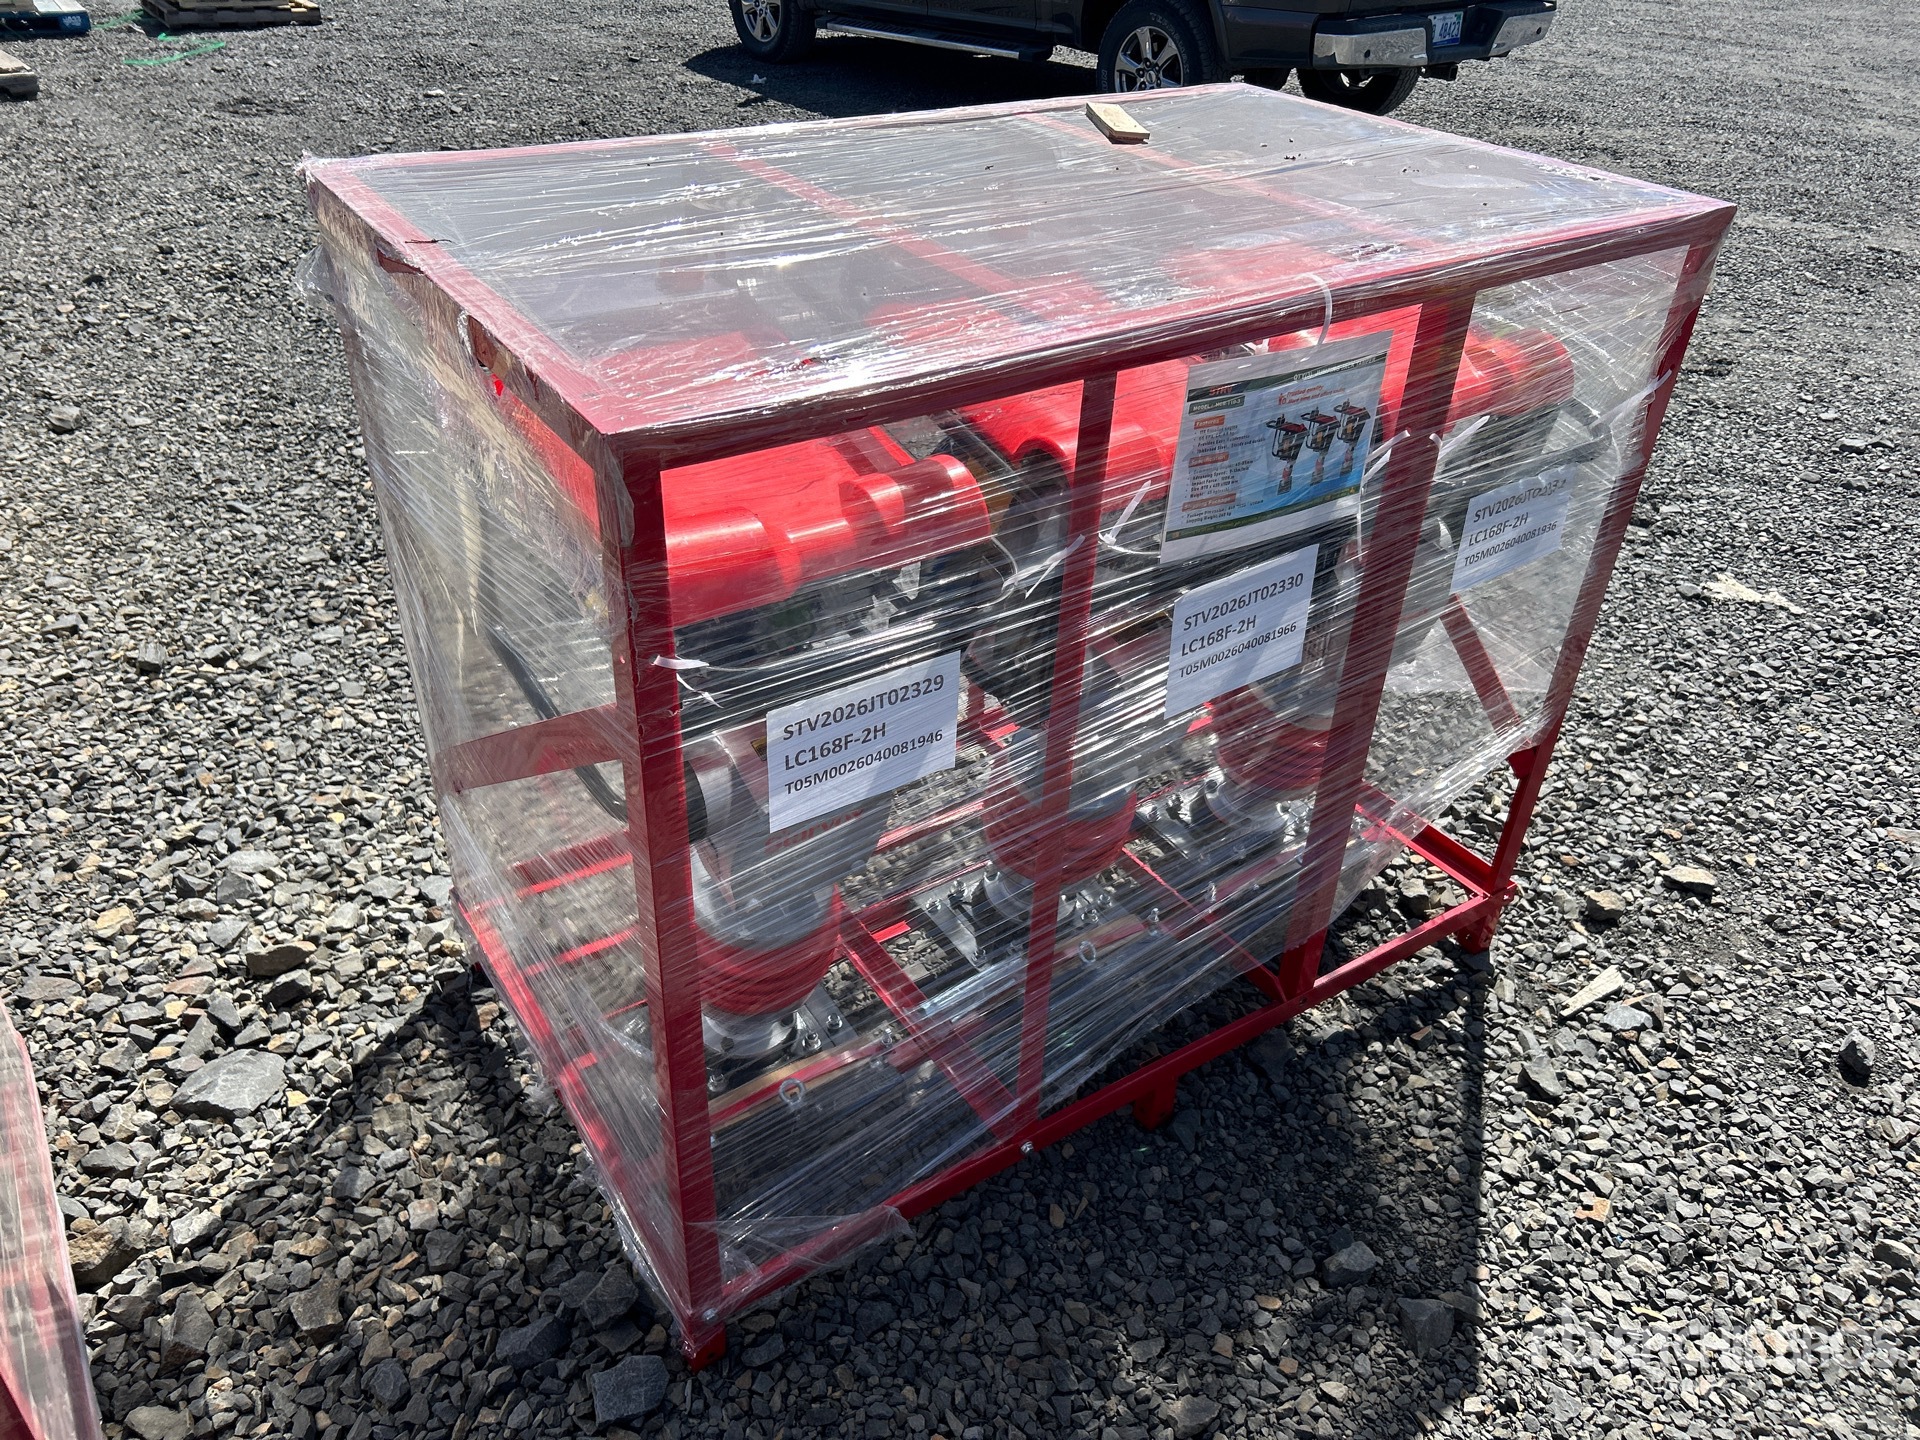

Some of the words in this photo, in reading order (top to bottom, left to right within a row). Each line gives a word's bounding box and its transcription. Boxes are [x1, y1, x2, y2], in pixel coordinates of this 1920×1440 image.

[1468, 512, 1529, 547] LC168F-2H
[1183, 573, 1304, 631] STV2026JT02330
[1179, 621, 1297, 678] T05M0026040081966
[1181, 615, 1257, 657] LC168F-2H
[782, 674, 944, 741] STV2026JT02329
[785, 722, 886, 771] LC168F-2H
[785, 729, 943, 794] T05M0026040081946
